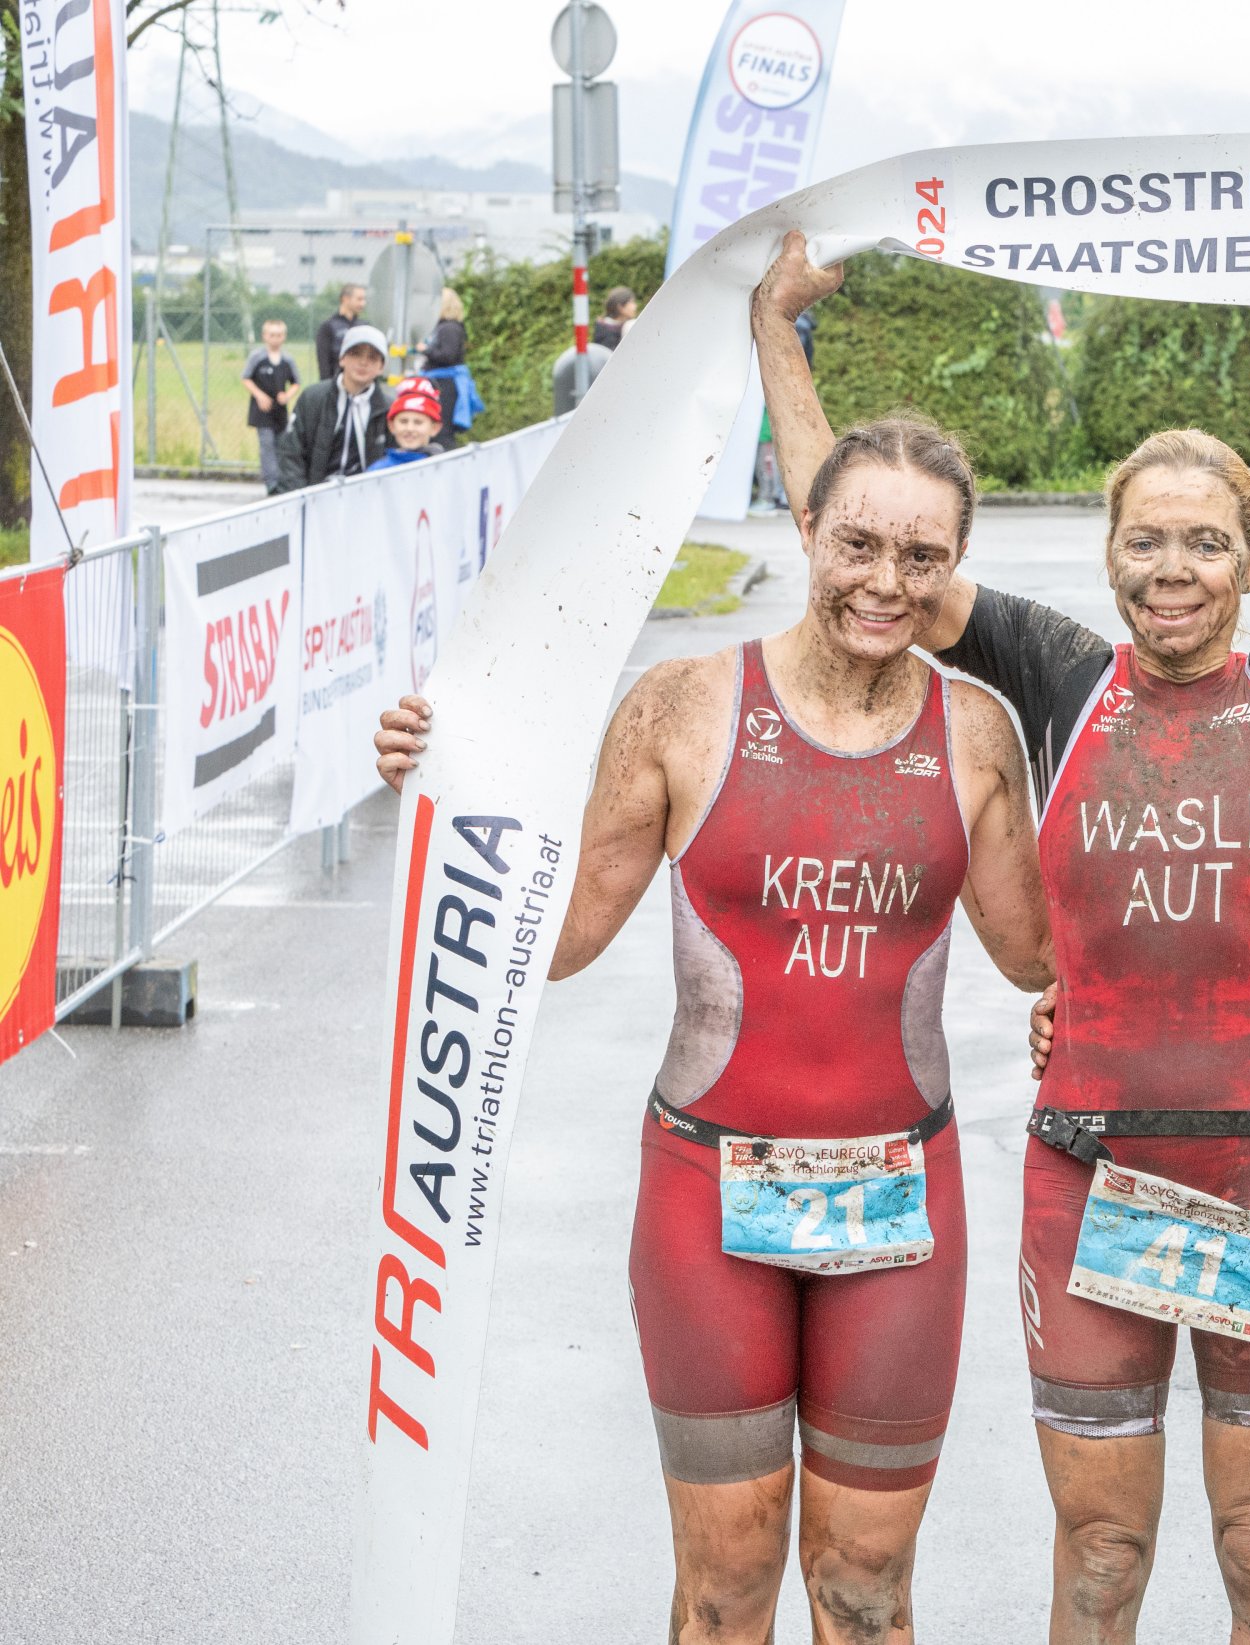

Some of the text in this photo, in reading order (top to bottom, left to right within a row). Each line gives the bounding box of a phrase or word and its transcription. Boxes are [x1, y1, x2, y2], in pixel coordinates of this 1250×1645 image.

[738, 52, 812, 82] FINALS
[916, 176, 946, 264] 024
[200, 589, 290, 729] STRABA
[740, 749, 783, 764] Trathlon
[1091, 723, 1137, 735] Triat
[761, 855, 920, 915] KRENN
[1122, 862, 1233, 926] AUT
[784, 924, 878, 979] AUT
[408, 815, 523, 1224] AUSTRIA
[464, 832, 563, 1248] www.triathlon-austria.at
[664, 1112, 695, 1131] TOUCH
[769, 1146, 805, 1159] ASVÖ
[821, 1145, 881, 1160] EUREGIO
[786, 1184, 868, 1250] 21
[1133, 1223, 1228, 1297] 41
[367, 1205, 446, 1451] TRI
